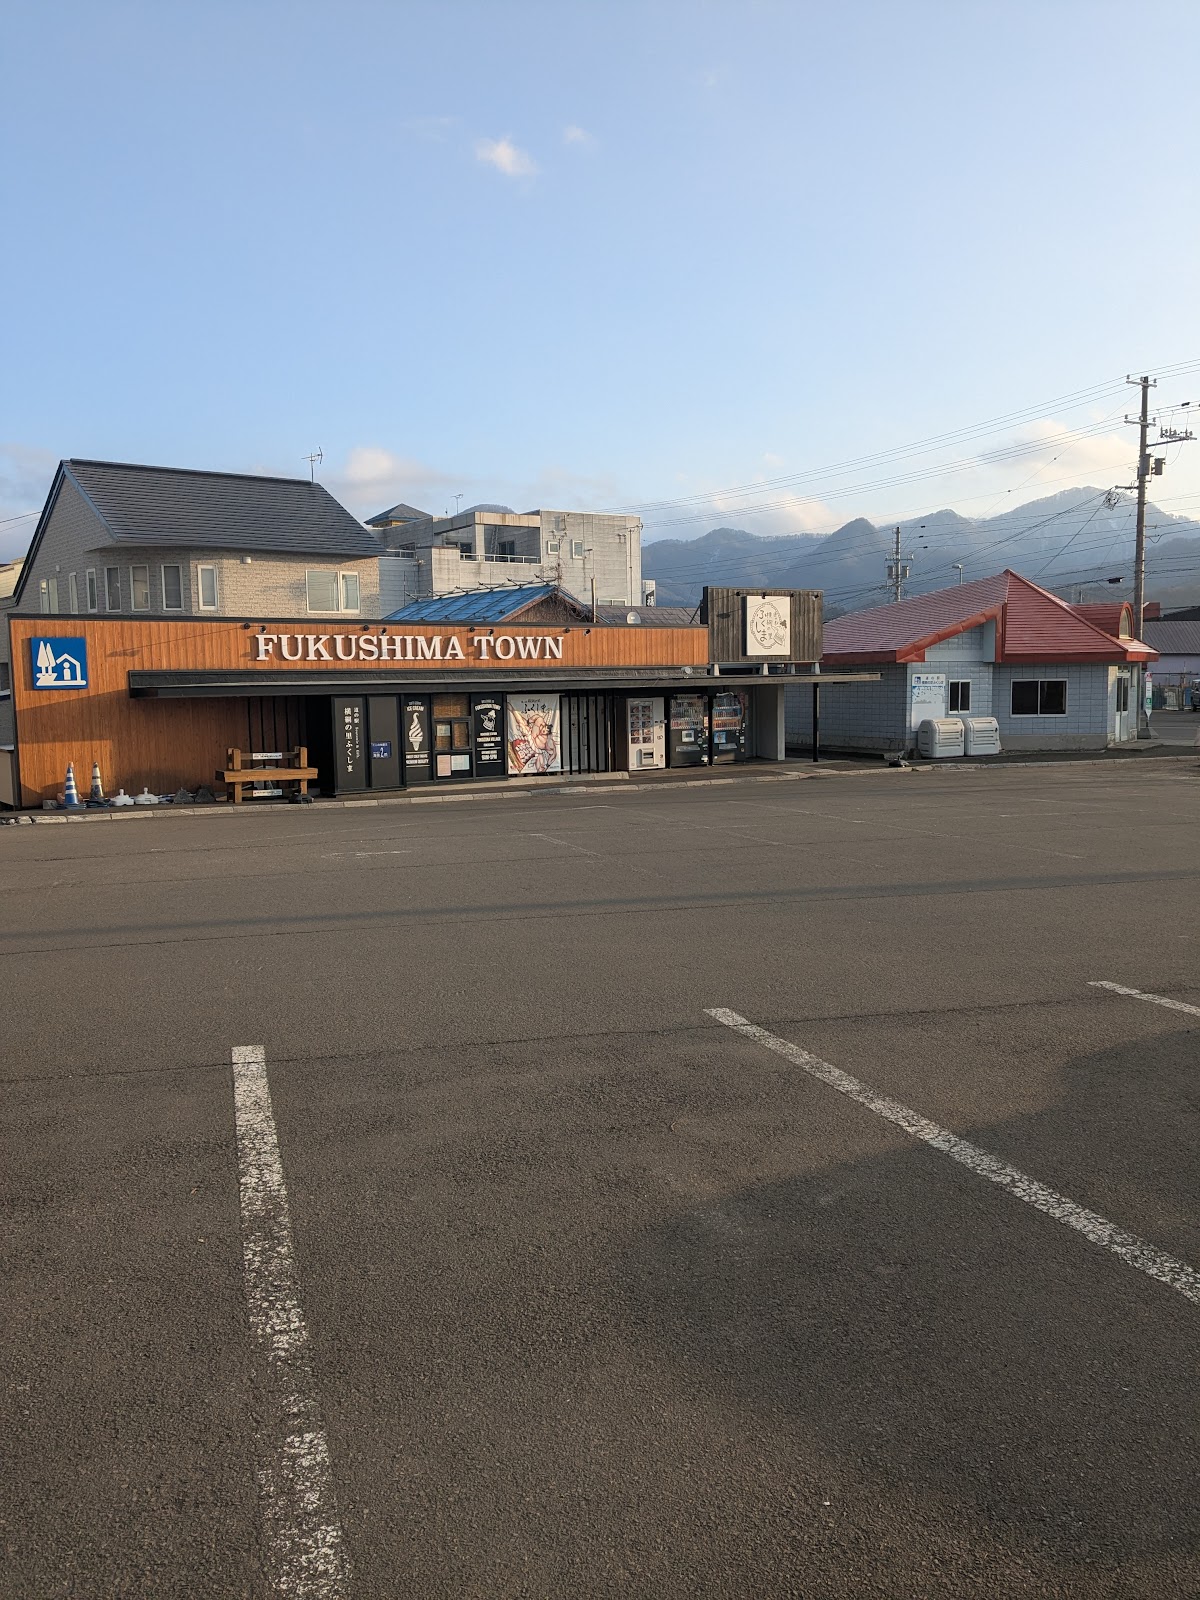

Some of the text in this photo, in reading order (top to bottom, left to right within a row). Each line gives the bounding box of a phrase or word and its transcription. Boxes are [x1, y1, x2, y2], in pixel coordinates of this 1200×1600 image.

[255, 634, 564, 660] FUKUSHIMA TOWN
[344, 707, 353, 773] 横綱の里ふくしま
